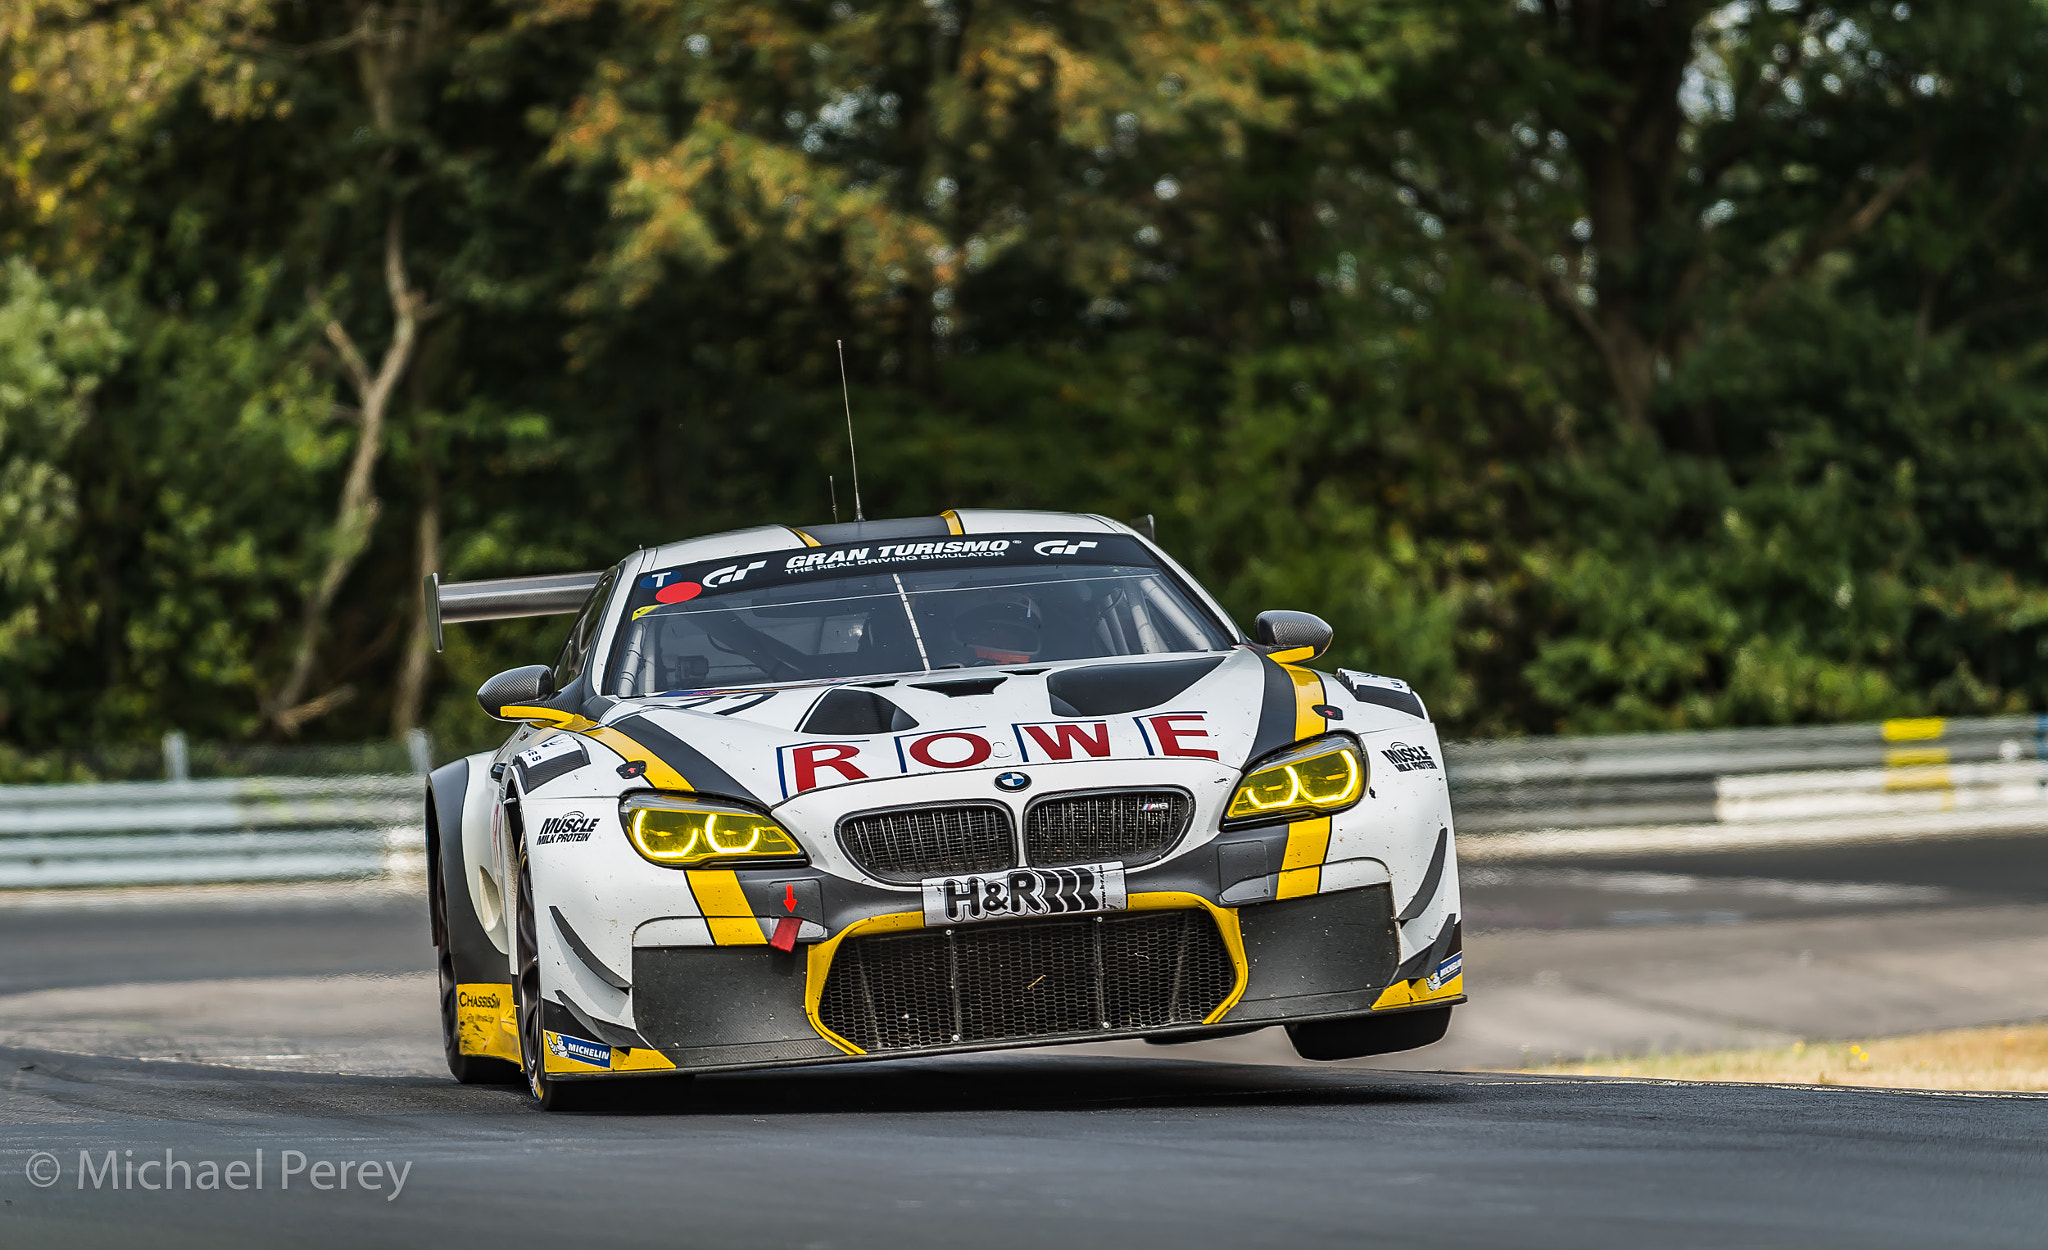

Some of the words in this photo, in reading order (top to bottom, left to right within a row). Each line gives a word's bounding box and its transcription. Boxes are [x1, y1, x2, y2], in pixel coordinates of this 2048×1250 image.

[784, 566, 814, 575] THE
[817, 562, 855, 571] REAL
[857, 555, 917, 566] DRIVING
[920, 551, 1006, 561] SIMULATOR
[785, 547, 870, 569] GRAN
[878, 539, 1010, 558] TURISMO
[652, 571, 672, 588] T
[792, 714, 1220, 794] ROWE
[1380, 745, 1433, 765] MUSCLE
[540, 817, 601, 835] MUSCLE
[536, 834, 556, 846] MILK
[556, 832, 592, 844] PROTEIN
[944, 870, 1048, 922] H&R
[567, 1042, 610, 1060] MICHELIN
